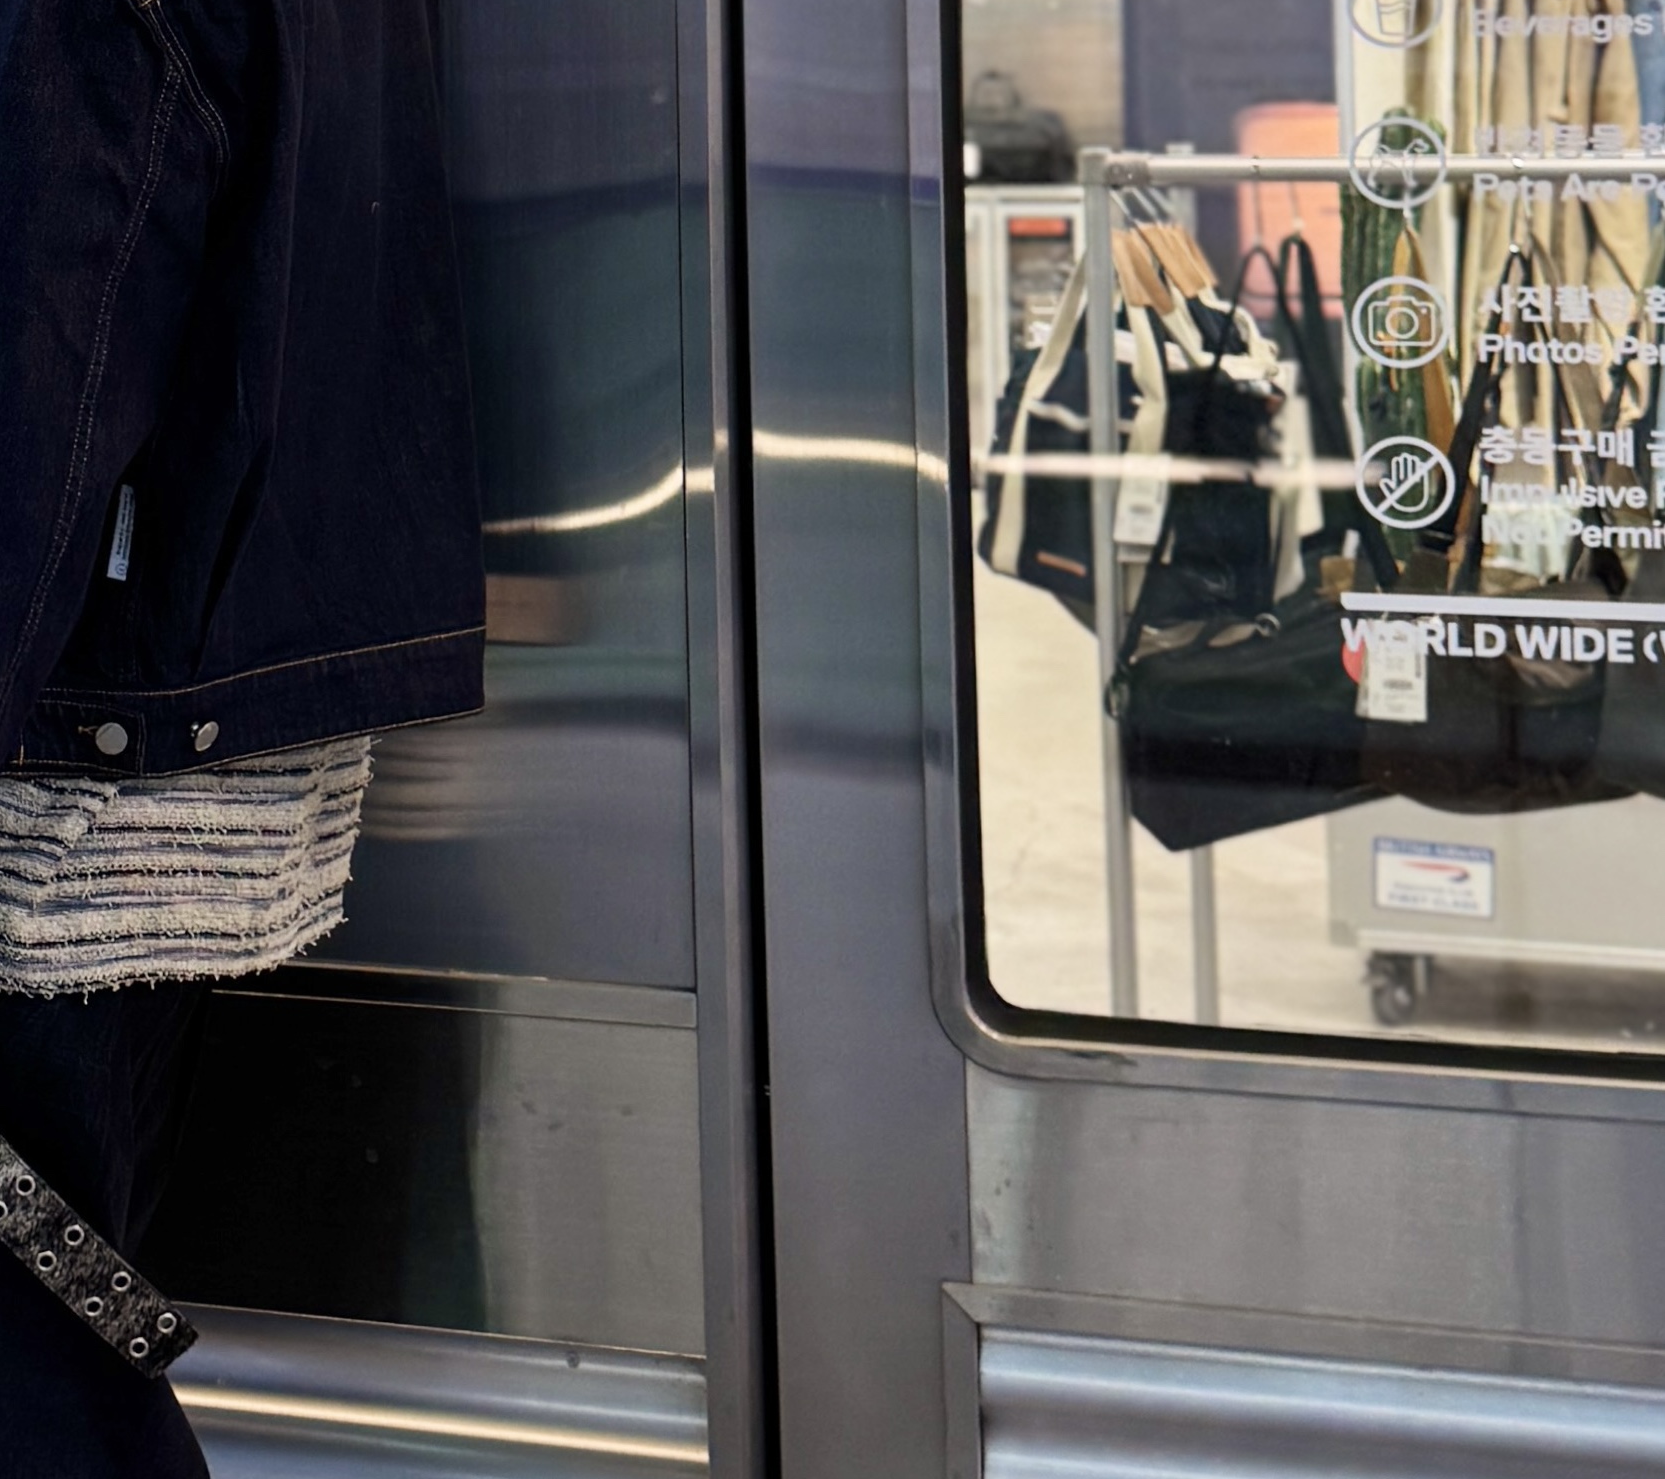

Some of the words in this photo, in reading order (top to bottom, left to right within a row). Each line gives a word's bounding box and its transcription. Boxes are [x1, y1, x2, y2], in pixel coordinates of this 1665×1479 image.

[1473, 173, 1552, 201] Pets
[1560, 172, 1621, 202] Are
[1478, 333, 1603, 365] Photos
[1478, 425, 1635, 467] 충동구매
[1480, 474, 1648, 509] Impulsive
[1340, 617, 1507, 658] WORLD
[1514, 624, 1635, 664] WIDE
